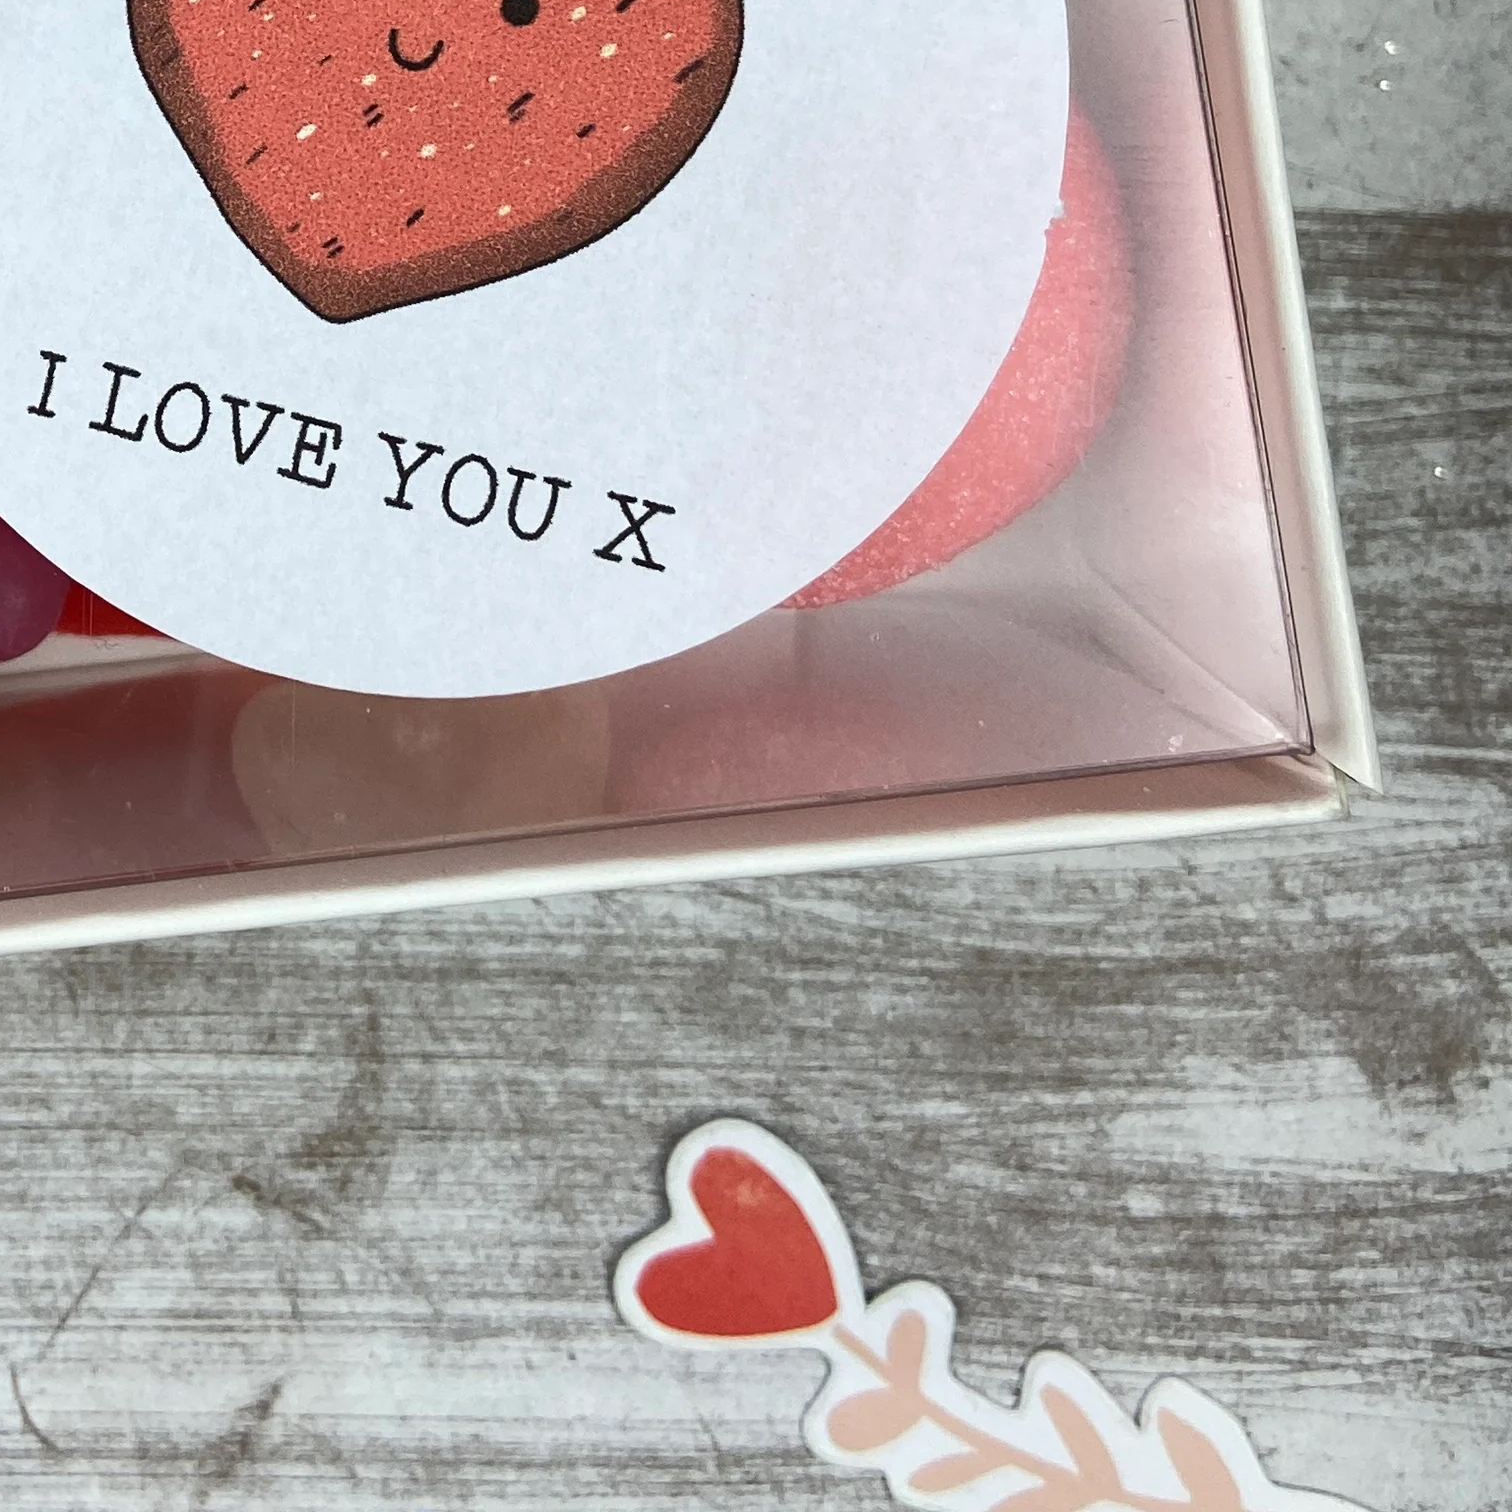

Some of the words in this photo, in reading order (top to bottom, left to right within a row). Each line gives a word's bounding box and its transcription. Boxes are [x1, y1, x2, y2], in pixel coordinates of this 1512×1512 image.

[27, 350, 67, 419] I
[88, 361, 343, 490] LOVE
[377, 431, 573, 542] YOU
[592, 490, 676, 573] X
